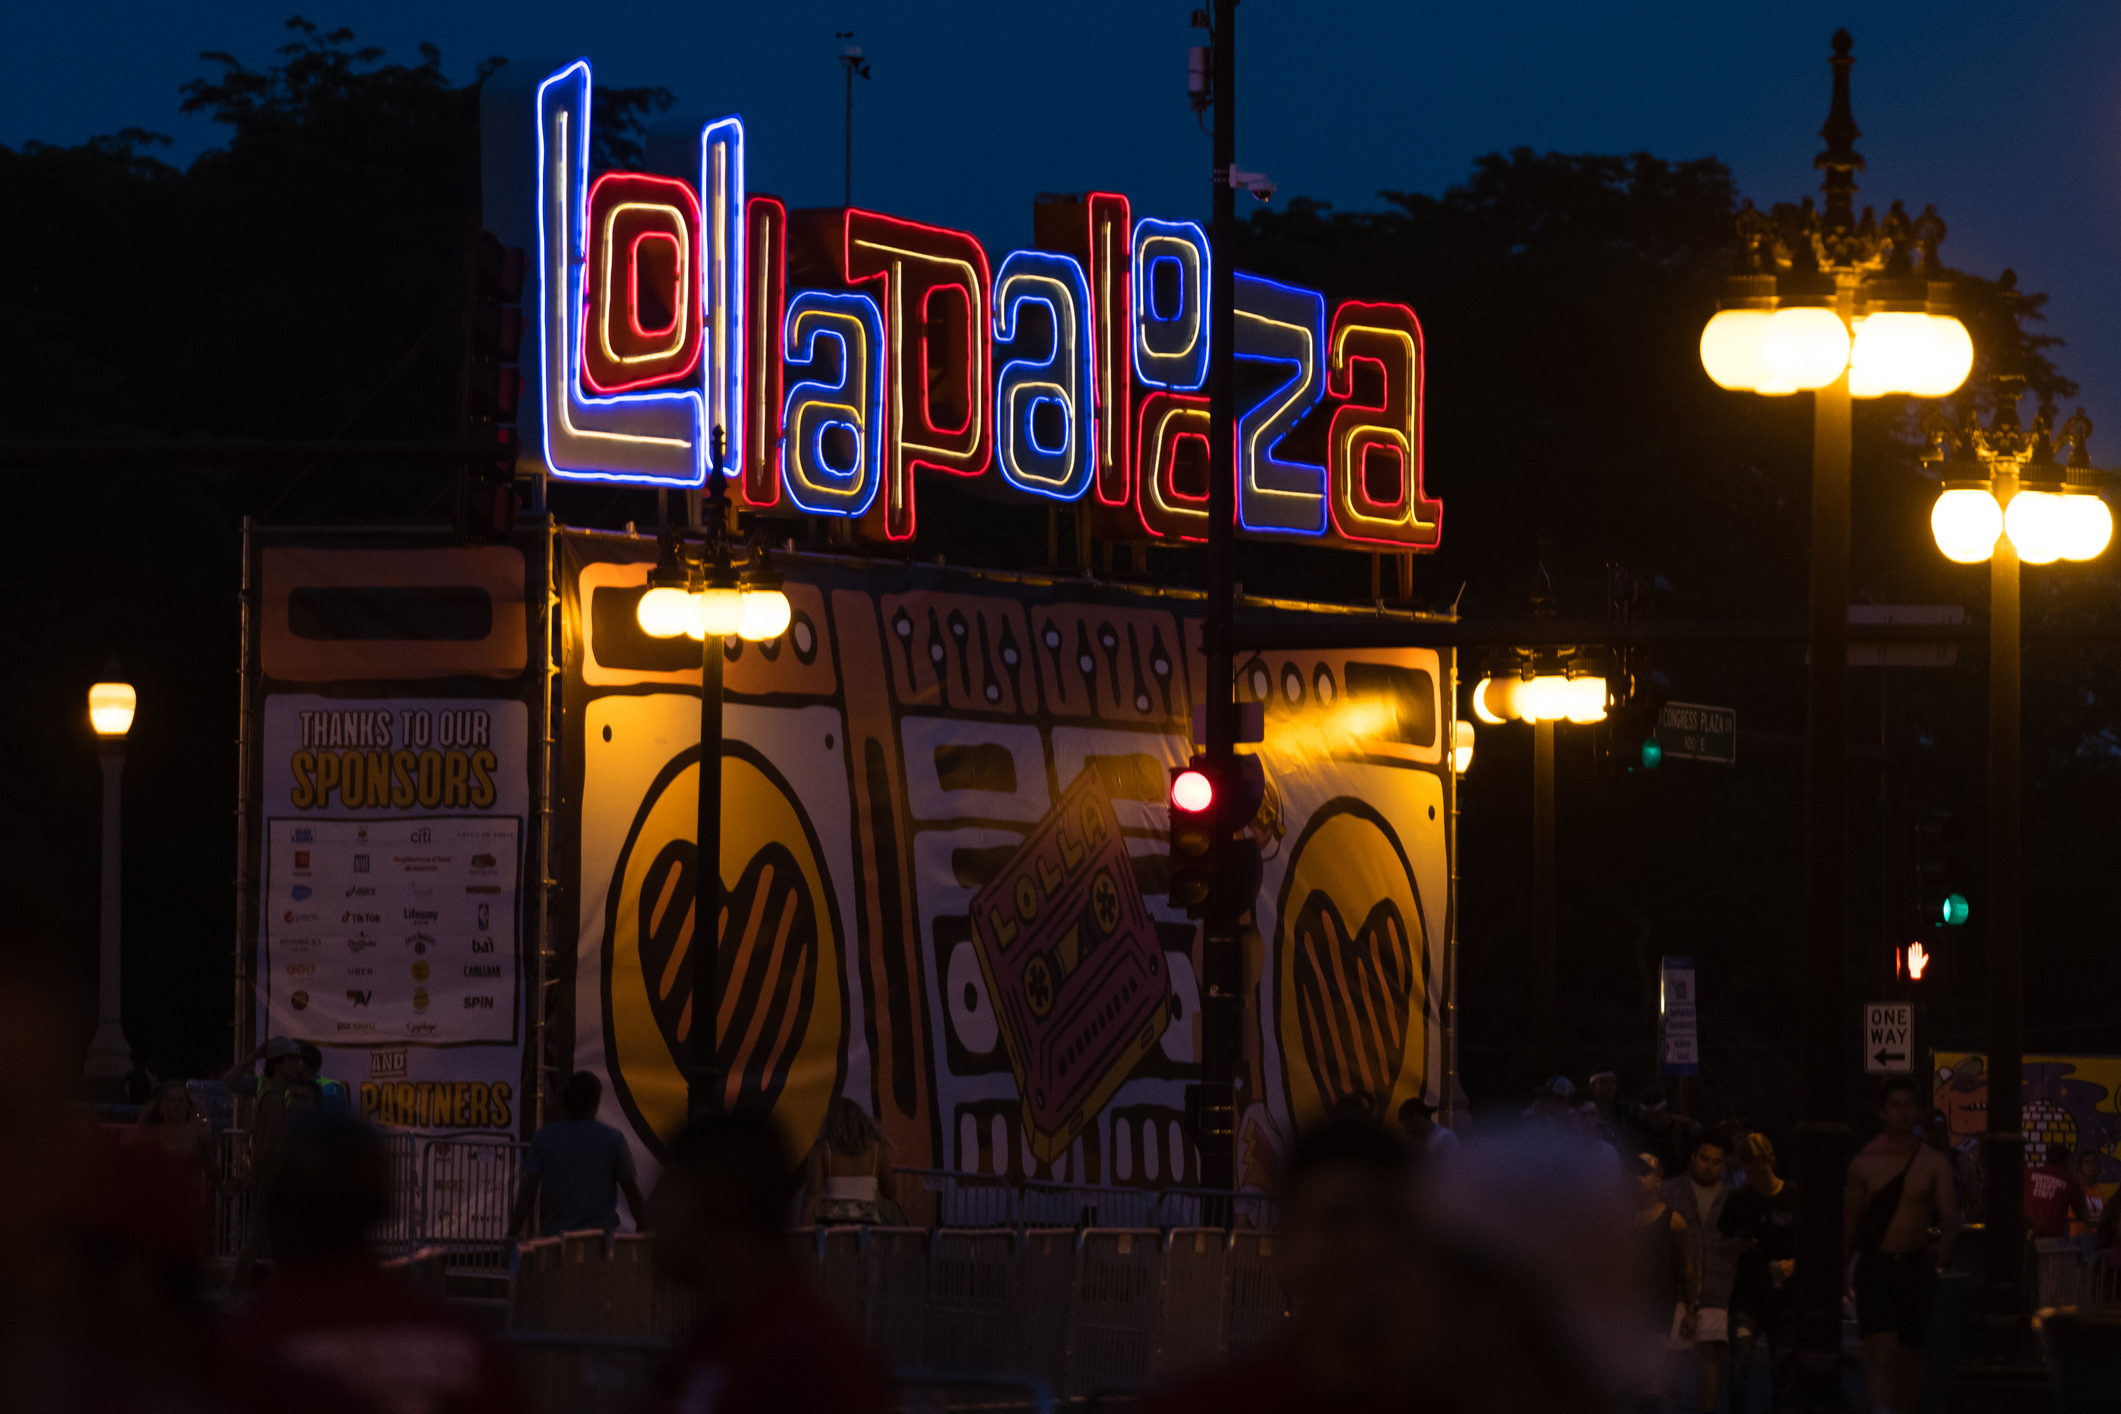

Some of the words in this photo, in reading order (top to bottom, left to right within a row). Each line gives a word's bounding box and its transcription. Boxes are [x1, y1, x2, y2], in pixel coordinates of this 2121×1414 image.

[300, 710, 391, 747] THANKS
[400, 711, 431, 746] TO
[438, 710, 490, 746] OUR
[1663, 706, 1697, 730] CONGRESS
[1700, 711, 1724, 734] PLAZA
[291, 750, 497, 809] SPONSORS
[410, 827, 432, 844] citi
[988, 793, 1108, 954] LOLLA
[403, 907, 439, 921] Lifeway
[472, 937, 494, 953] bai
[347, 967, 373, 976] UBER
[464, 965, 501, 978] CAMELBAK
[1871, 1008, 1907, 1025] ONE
[1870, 1028, 1907, 1045] WAY
[372, 1053, 404, 1072] AND
[360, 1081, 512, 1128] PARTNERS
